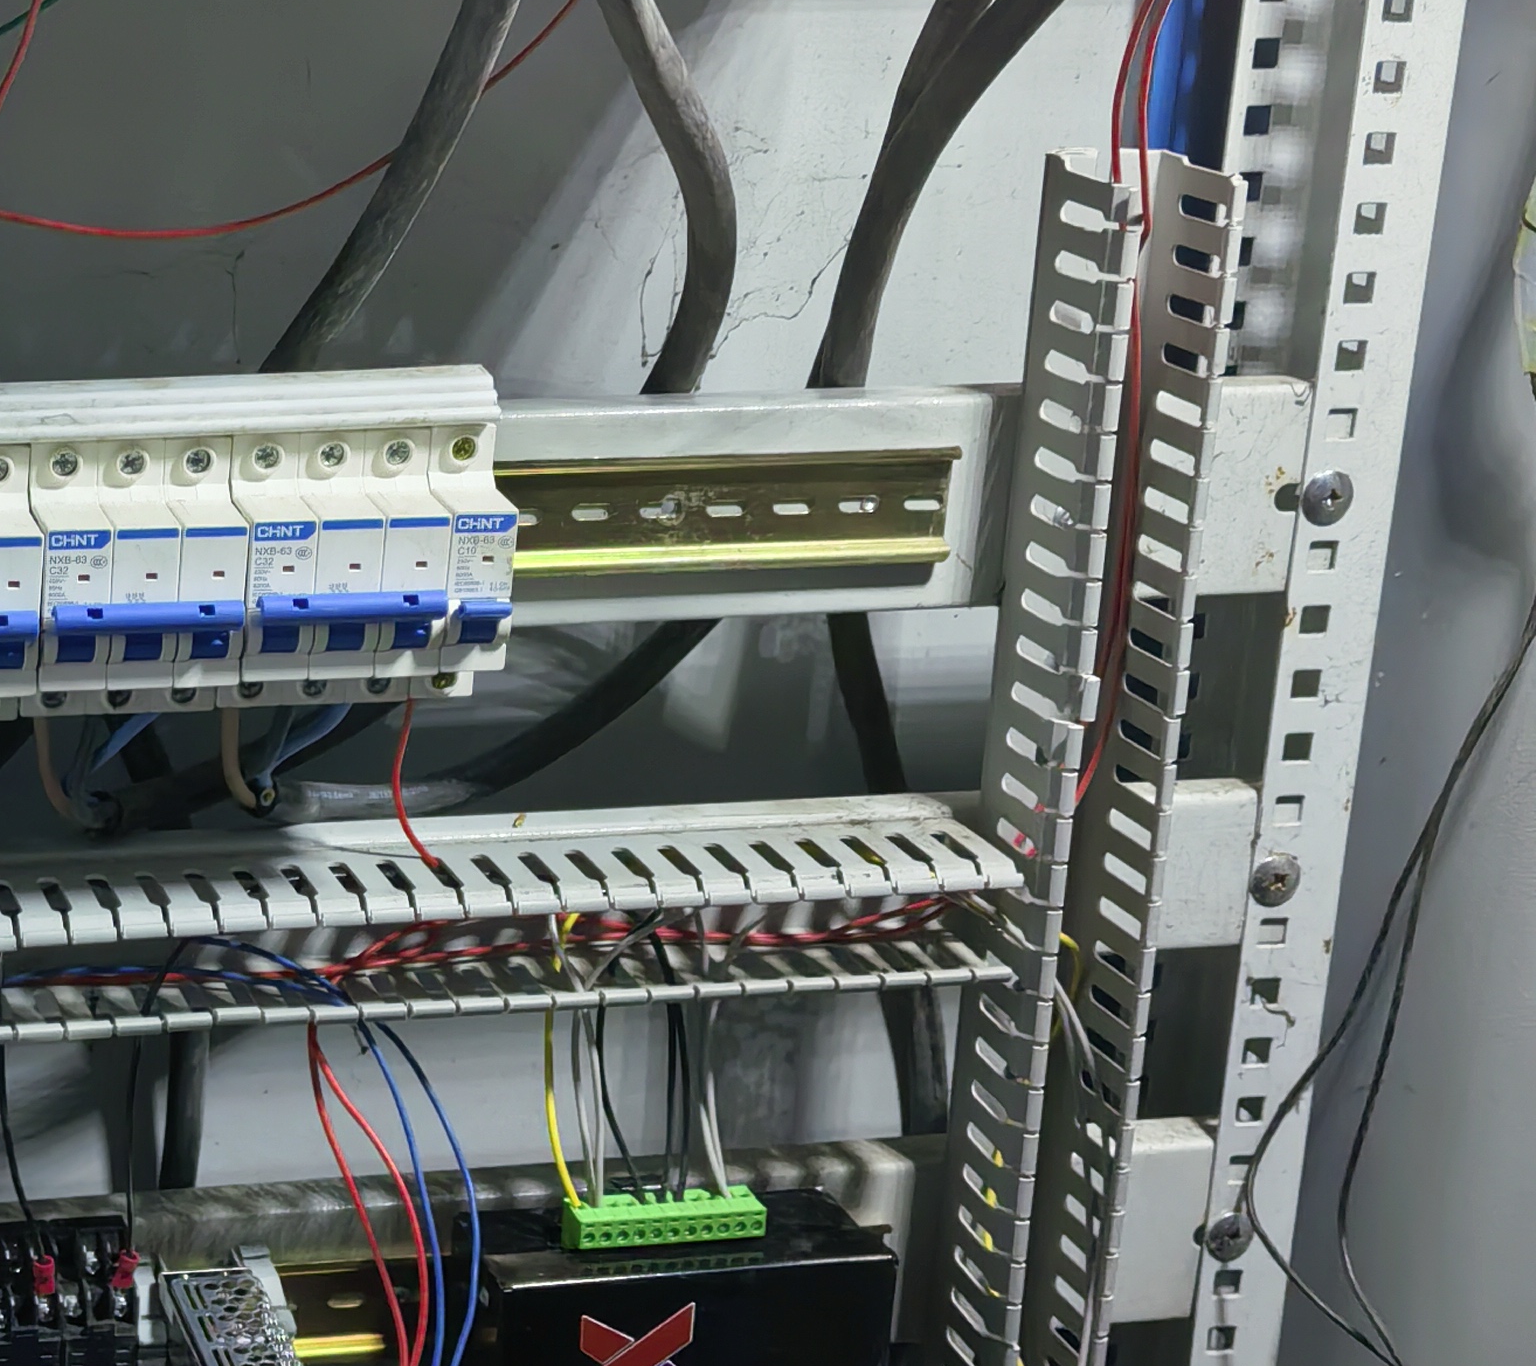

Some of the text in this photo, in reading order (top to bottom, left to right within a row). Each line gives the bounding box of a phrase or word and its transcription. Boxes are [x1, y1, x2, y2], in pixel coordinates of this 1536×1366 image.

[254, 546, 293, 556] NXB-63
[457, 546, 478, 555] C10
[49, 555, 87, 565] NXB-63
[254, 557, 275, 566] C32
[49, 566, 69, 575] C32
